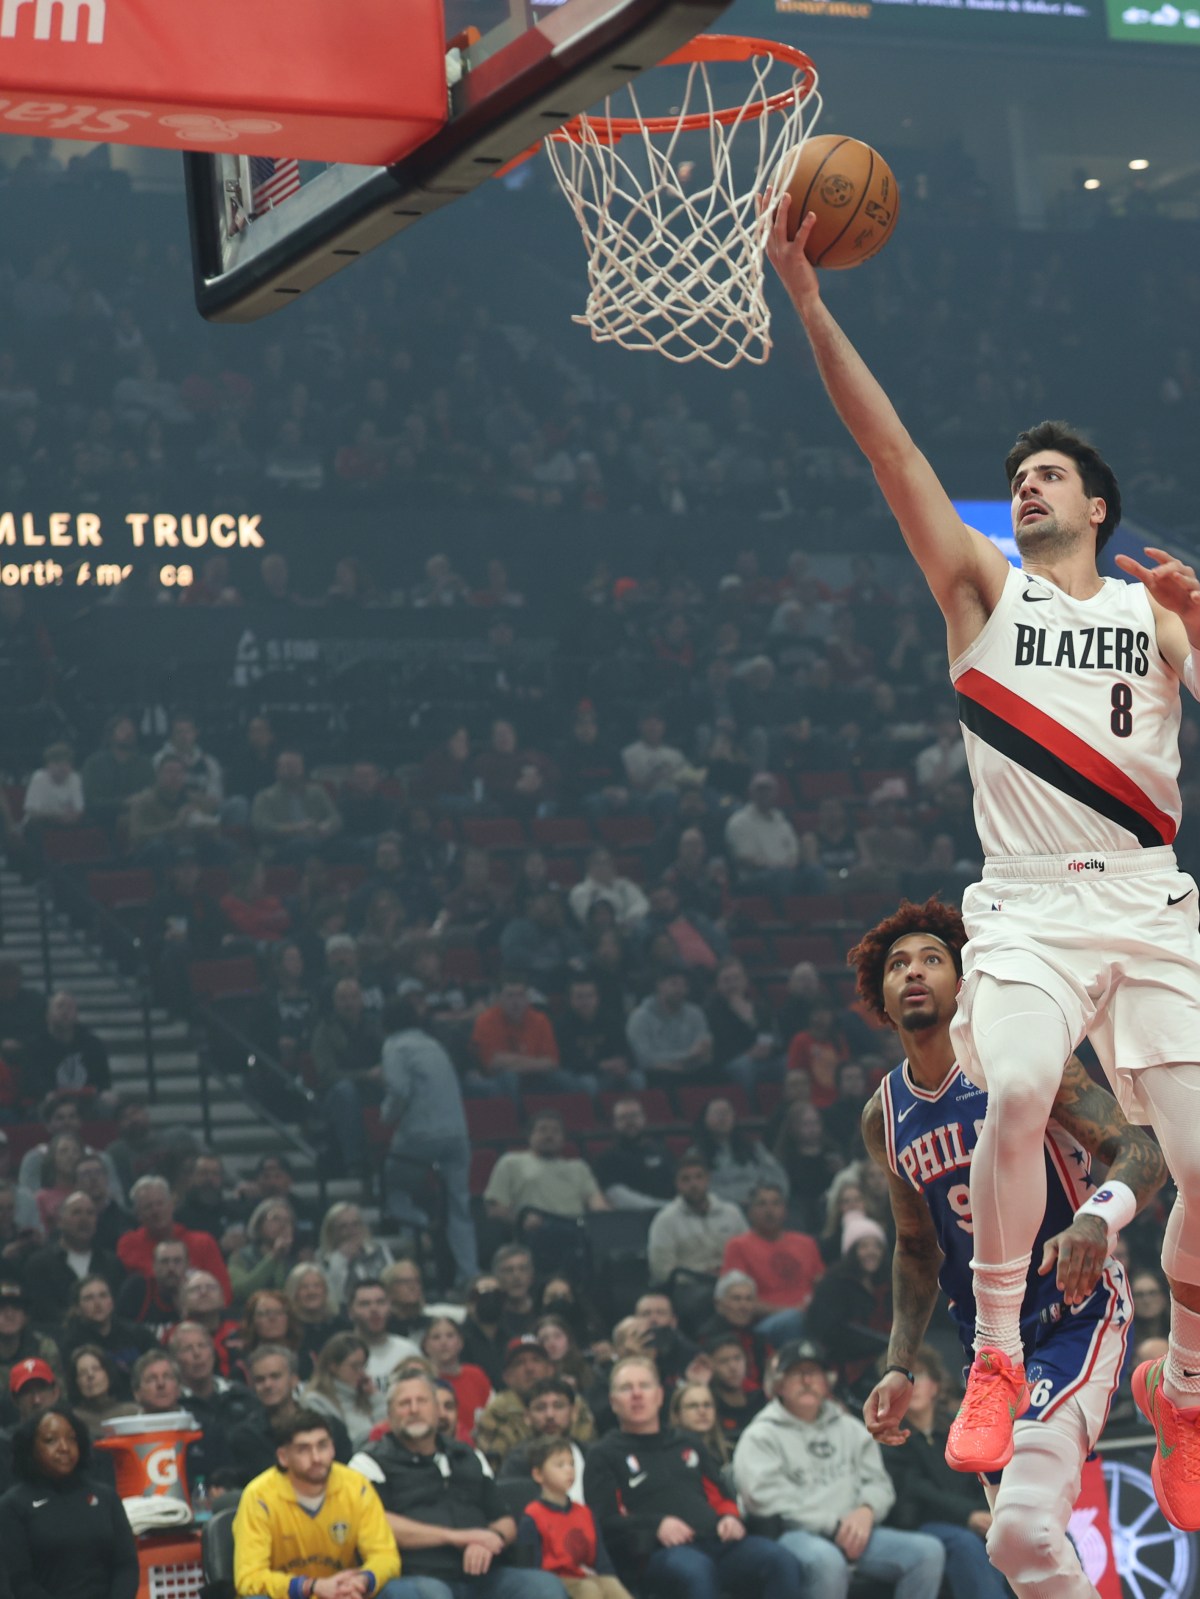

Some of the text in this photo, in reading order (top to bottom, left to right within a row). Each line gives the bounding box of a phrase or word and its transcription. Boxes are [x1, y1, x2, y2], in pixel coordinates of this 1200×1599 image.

[125, 513, 265, 548] TRUCK
[0, 558, 64, 587] orth
[1013, 622, 1150, 677] BLAZERS
[1110, 682, 1133, 738] 8
[1068, 858, 1105, 872] ripcity
[147, 1449, 178, 1485] G
